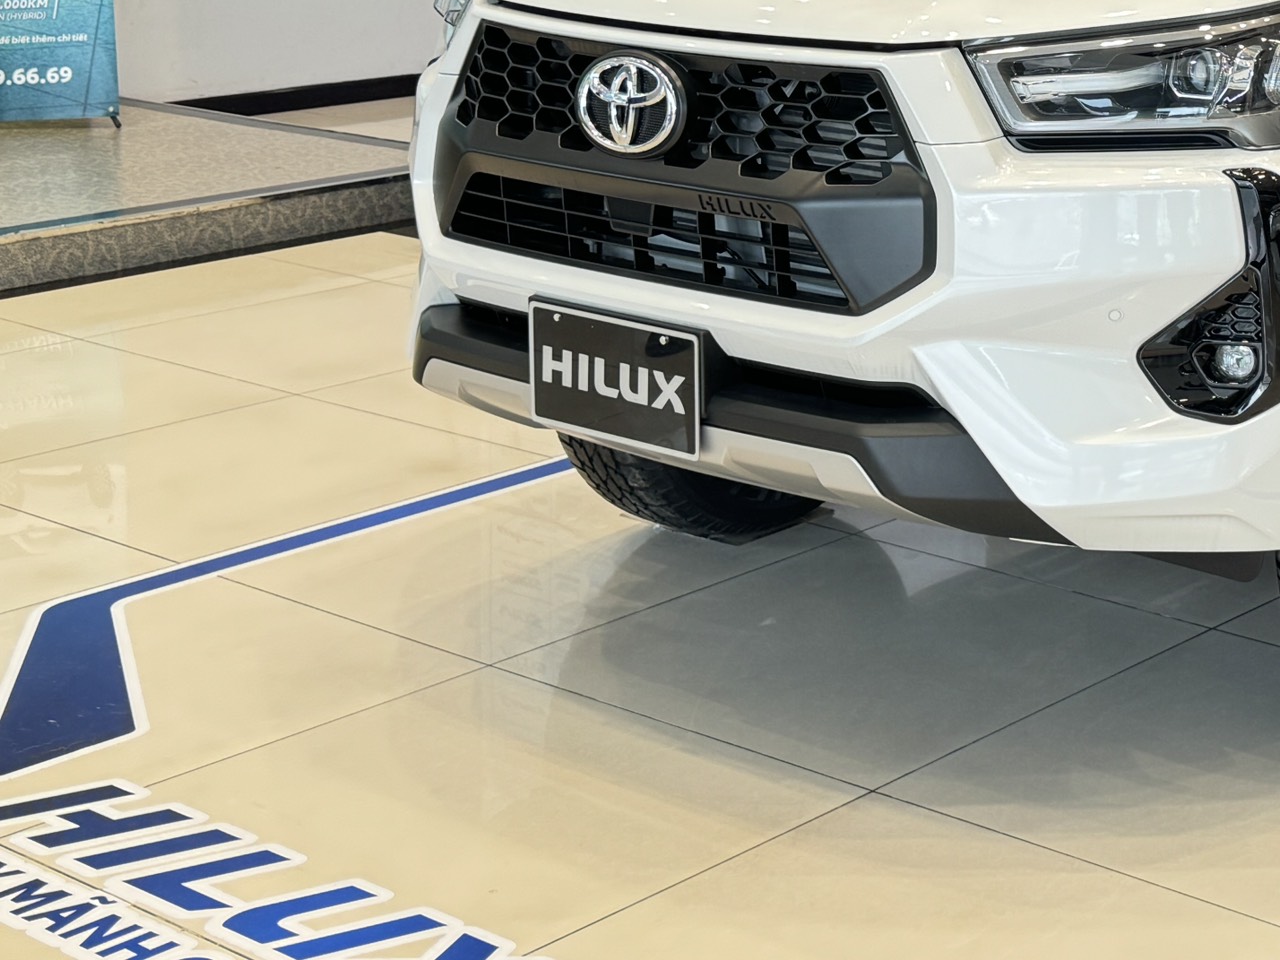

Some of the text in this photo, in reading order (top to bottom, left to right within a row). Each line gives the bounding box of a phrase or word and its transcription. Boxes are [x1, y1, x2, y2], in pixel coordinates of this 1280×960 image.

[7, 11, 47, 22] (HYBRID)
[699, 193, 776, 221] HILUX
[541, 344, 686, 416] HILUX
[0, 782, 505, 960] HILU
